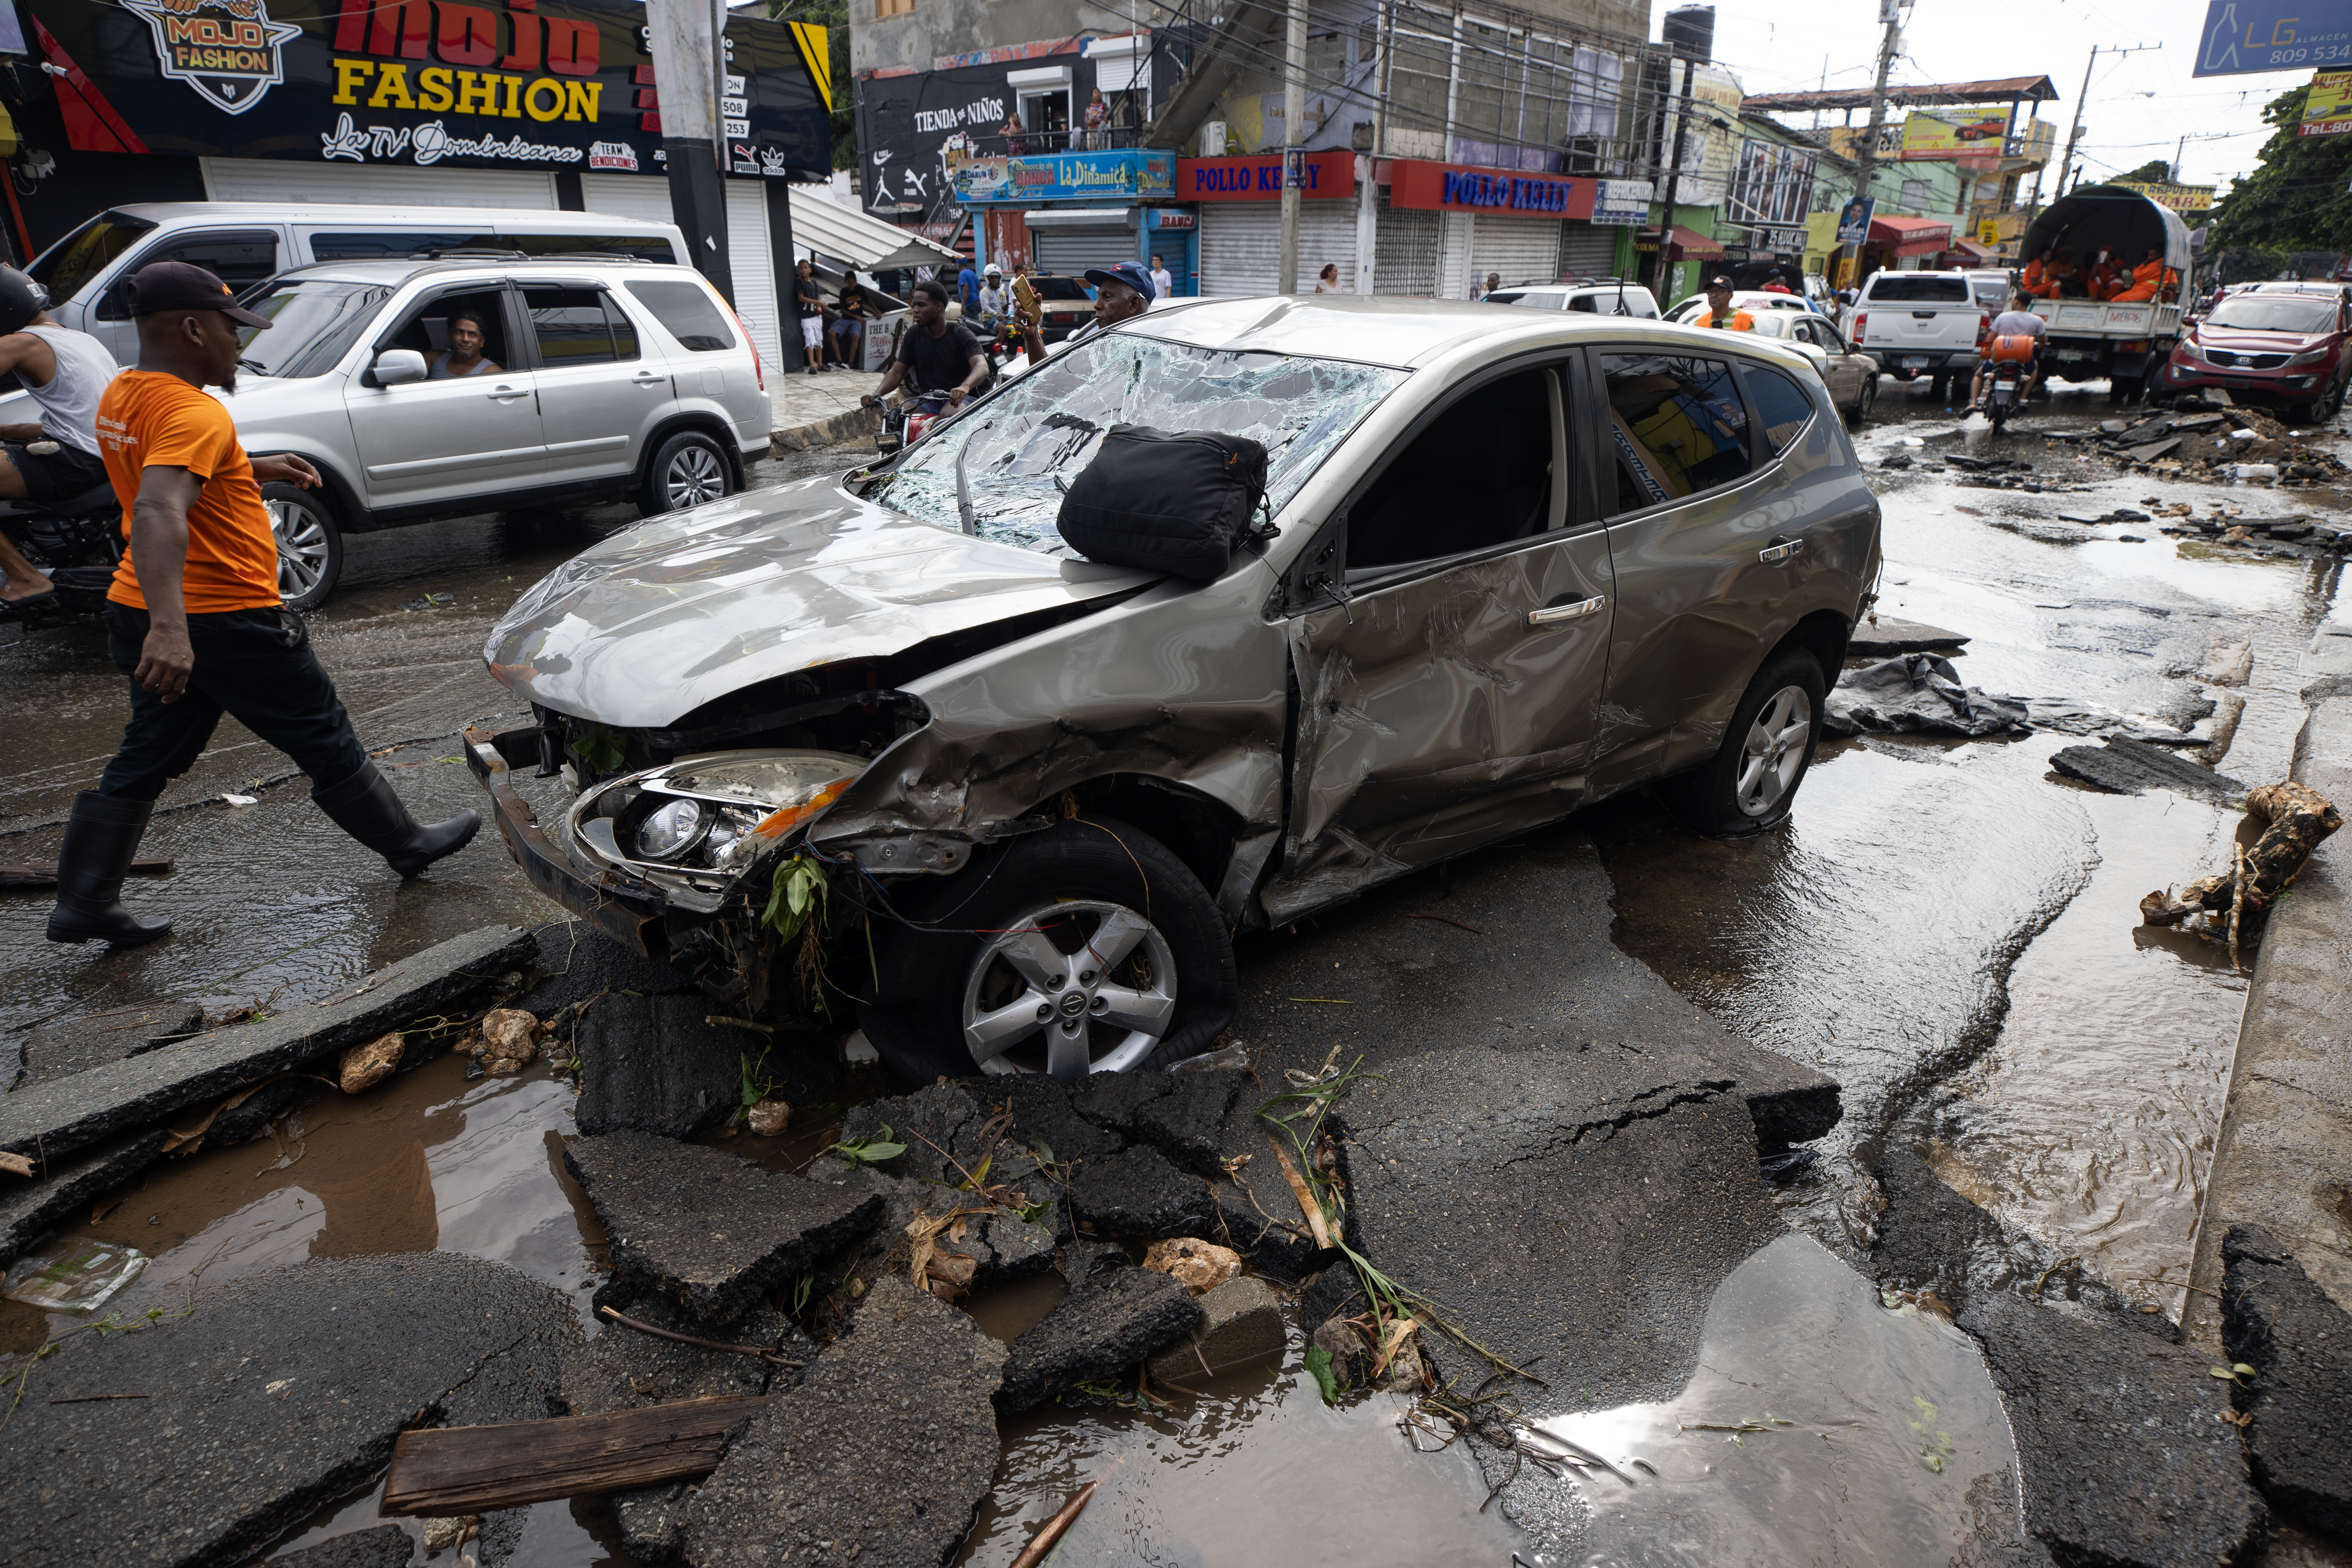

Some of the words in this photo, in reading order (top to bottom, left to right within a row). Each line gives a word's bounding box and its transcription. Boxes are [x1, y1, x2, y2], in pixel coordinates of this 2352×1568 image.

[166, 16, 264, 48] MOJO
[2295, 33, 2348, 43] ALMACEN
[176, 46, 268, 71] FASHION
[2269, 48, 2307, 64] 809
[2312, 44, 2351, 60] 534
[333, 58, 603, 122] FASHION
[723, 102, 743, 113] 508
[914, 107, 958, 132] TIENDA
[957, 108, 966, 121] DE
[967, 97, 1004, 125] NIÑOS
[322, 112, 370, 162] La
[369, 126, 410, 158] TV
[412, 119, 584, 165] Dominicana
[601, 144, 623, 155] TEAM
[591, 156, 637, 169] BENDICIONES
[735, 163, 758, 172] PUMA
[1016, 162, 1044, 171] Consorcio
[1016, 170, 1055, 186] BANCA
[1060, 159, 1072, 186] La
[1075, 160, 1126, 185] Dinamica
[1196, 167, 1250, 191] POLLO
[1442, 171, 1510, 206] POLLO
[1511, 178, 1572, 211] KELLY
[2148, 185, 2214, 194] REPUESTOS
[949, 208, 962, 219] TEAM
[869, 324, 883, 335] THE
